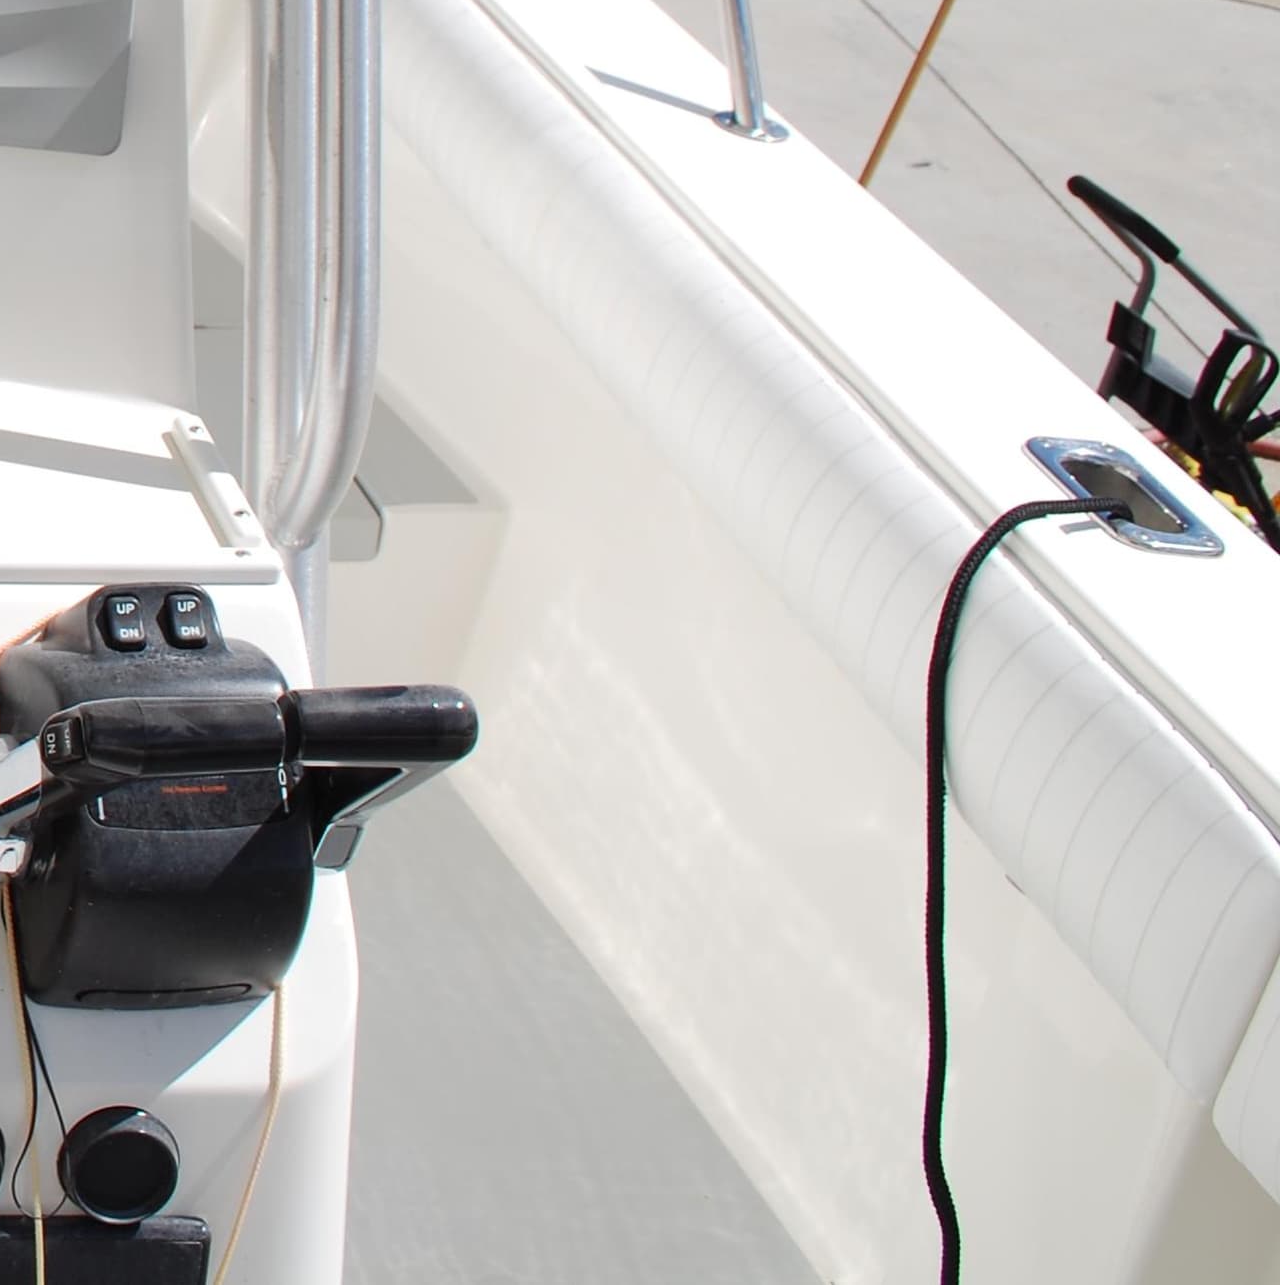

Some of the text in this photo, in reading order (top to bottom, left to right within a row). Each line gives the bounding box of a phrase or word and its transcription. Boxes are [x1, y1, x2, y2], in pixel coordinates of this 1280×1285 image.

[116, 602, 135, 615] UP
[177, 600, 197, 612] UP
[119, 628, 139, 639] DN
[180, 626, 200, 636] DN
[46, 732, 57, 754] DN
